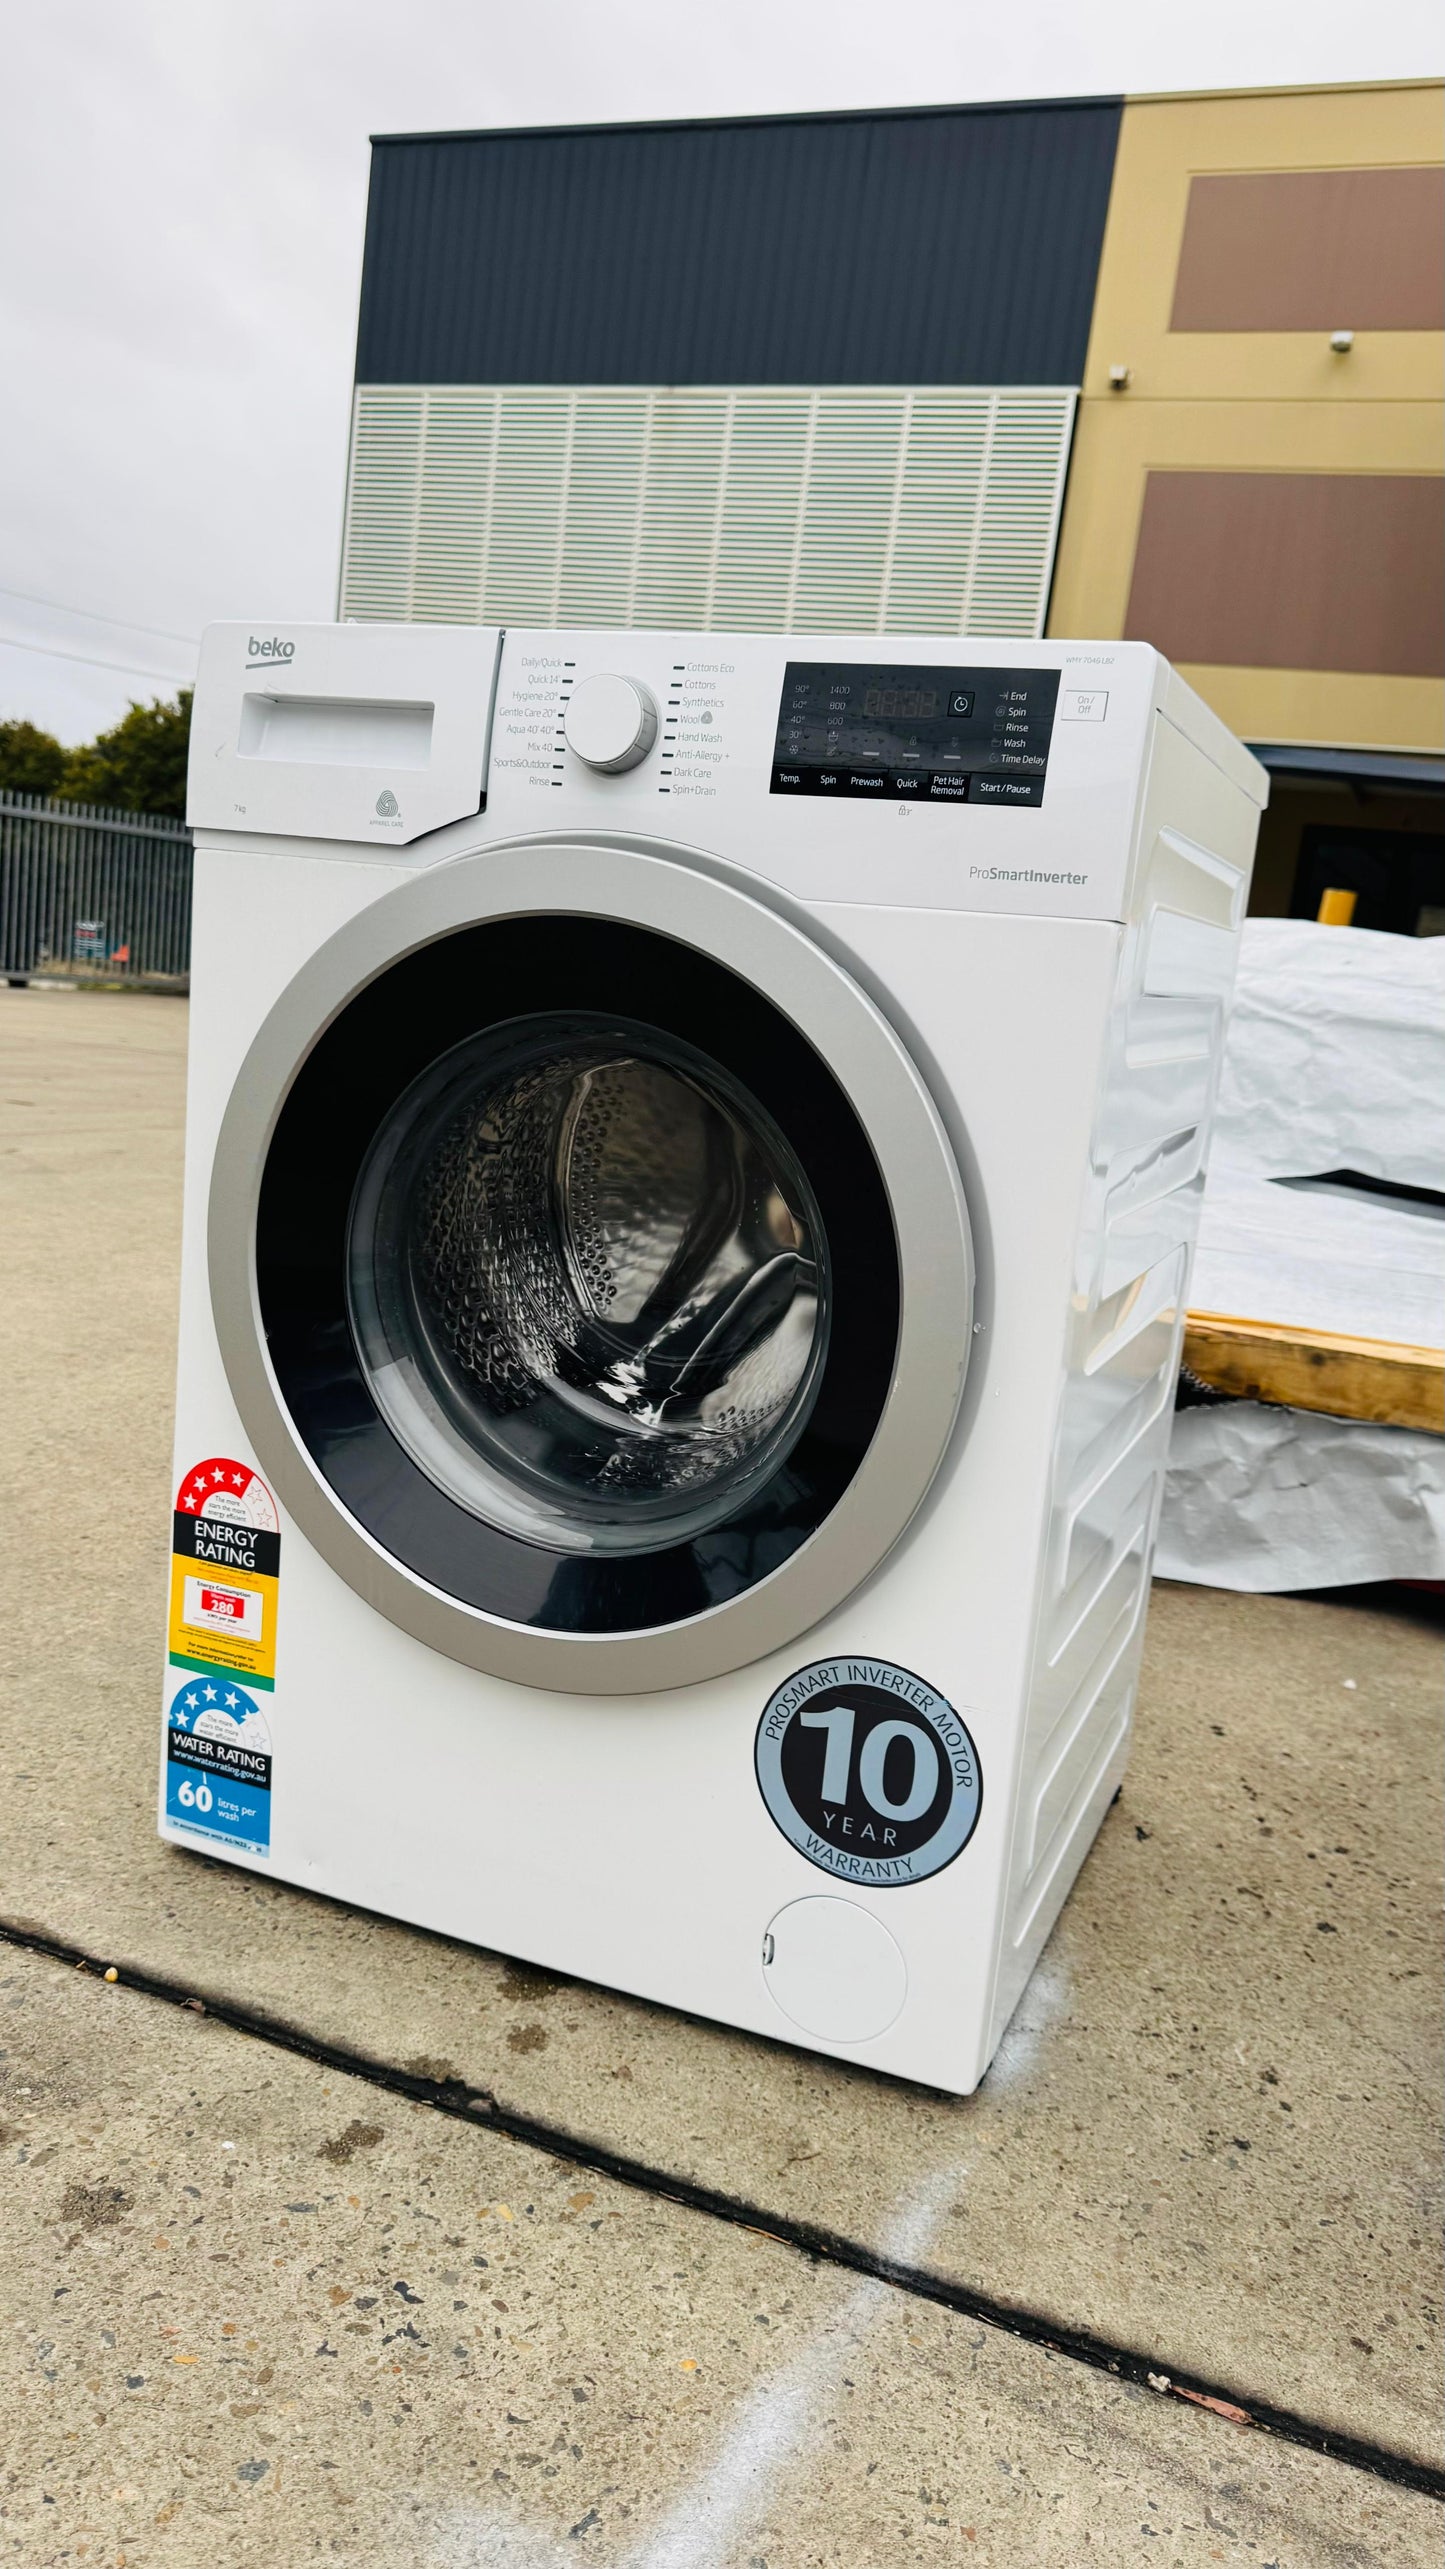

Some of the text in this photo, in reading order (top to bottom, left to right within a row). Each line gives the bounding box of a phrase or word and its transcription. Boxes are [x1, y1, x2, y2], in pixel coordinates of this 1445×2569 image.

[248, 636, 295, 658] beko
[687, 662, 735, 673] Cottons Eco
[528, 674, 547, 685] Quick
[685, 679, 716, 690] Cottons
[830, 686, 850, 694] 1400
[512, 691, 543, 702] Hygiene
[682, 696, 724, 708] Synthetics
[1010, 692, 1028, 701] End
[829, 702, 846, 710] 800
[1078, 705, 1091, 713] Off
[499, 707, 523, 717] Gentle
[524, 708, 541, 717] Care
[1008, 707, 1026, 717] Spin
[680, 714, 700, 724] Wool
[506, 724, 526, 735] Aqua
[1005, 723, 1029, 733] Rinse
[678, 732, 723, 743] Hand Wash
[528, 742, 553, 752] Mix 40
[1003, 739, 1026, 748] Wash
[675, 749, 723, 763] Anti-Allergy
[1001, 754, 1046, 767] Time Delay
[494, 758, 551, 769] Sports&Outdoor
[674, 767, 712, 778] Dark Care
[529, 776, 550, 786] Rinse
[779, 773, 801, 784] Temp.
[820, 775, 837, 786] Spin
[850, 776, 884, 787] Prewash
[896, 778, 918, 789] Quick
[933, 775, 965, 786] Pet Hair
[672, 784, 716, 796] Spin+Drain
[930, 785, 965, 796] Removal
[969, 865, 1088, 885] ProSmartInverter
[195, 1520, 259, 1549] ENERGY
[195, 1539, 255, 1568] RATING
[197, 1580, 251, 1598] Energy Consumption
[211, 1600, 235, 1615] 280
[765, 1665, 973, 1788] PROSMART INVERTER MOTOR
[173, 1732, 265, 1772] WATER RATING
[173, 1750, 267, 1782] www.waterrating.gov.au
[800, 1706, 939, 1822] 10
[178, 1781, 213, 1813] 60
[217, 1797, 257, 1818] litres per
[217, 1809, 240, 1823] wash
[823, 1811, 897, 1847] YEAR
[806, 1834, 914, 1878] WARRANTY
